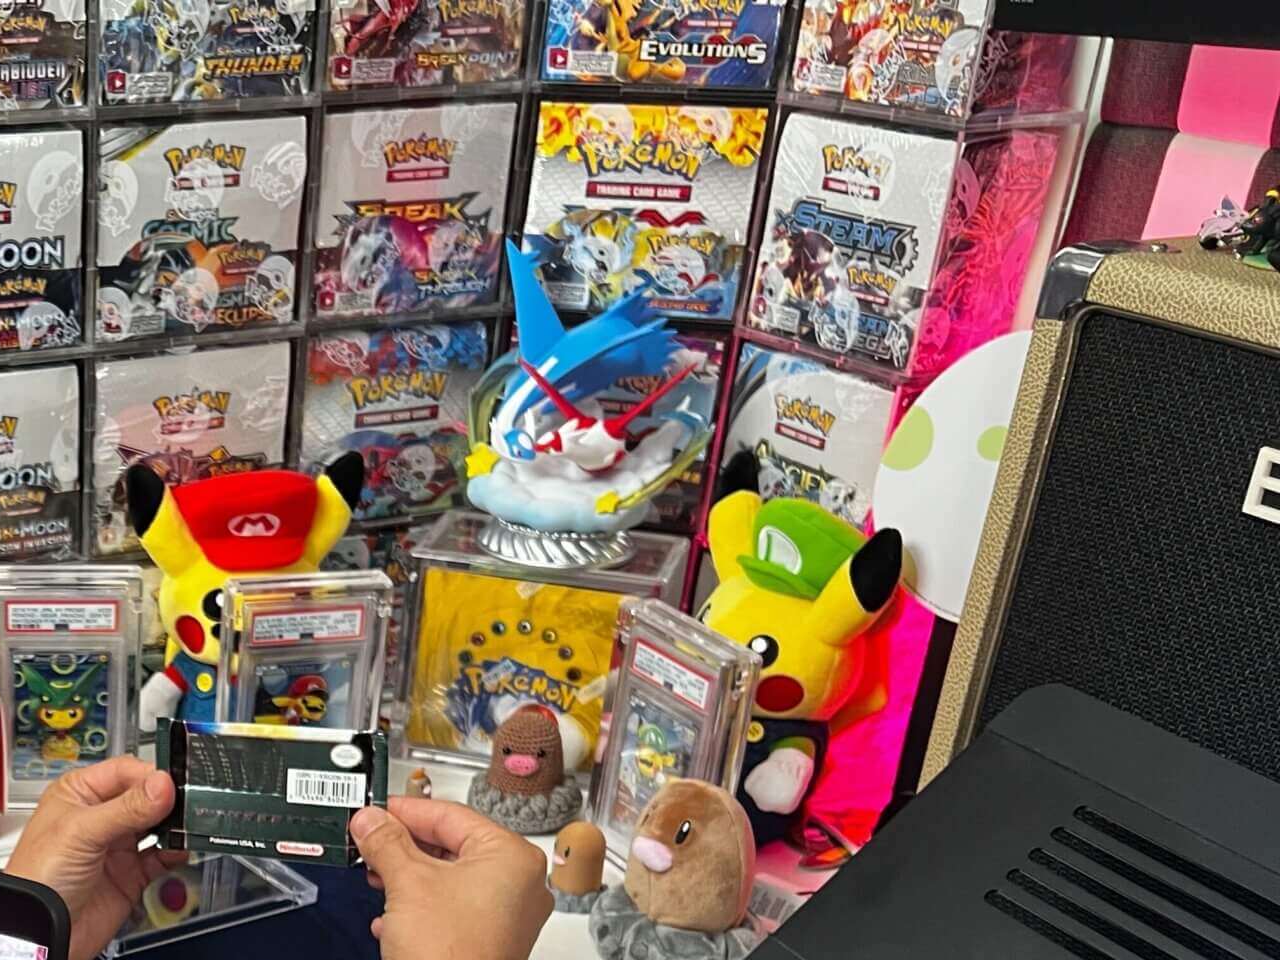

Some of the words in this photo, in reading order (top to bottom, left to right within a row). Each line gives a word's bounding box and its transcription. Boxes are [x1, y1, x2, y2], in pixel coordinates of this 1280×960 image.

[639, 40, 768, 65] EVOLUTIONS
[206, 54, 305, 77] THUNDER
[794, 201, 897, 255] STEAM
